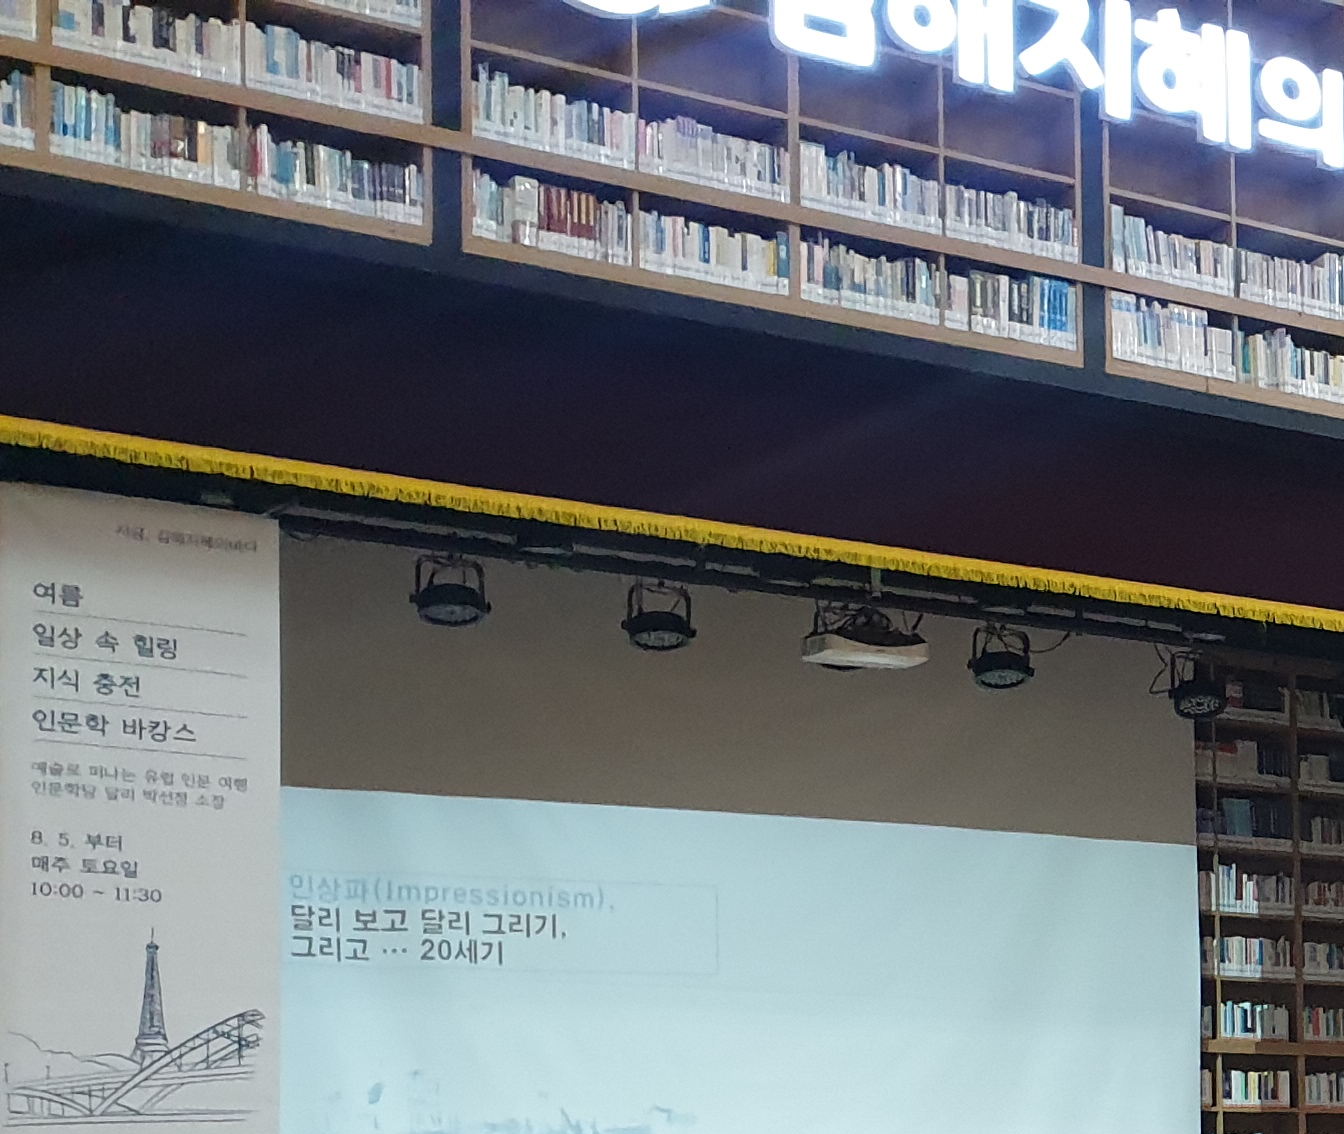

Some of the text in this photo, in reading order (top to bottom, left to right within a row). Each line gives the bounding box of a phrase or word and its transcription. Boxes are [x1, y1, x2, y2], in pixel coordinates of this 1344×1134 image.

[33, 583, 83, 607] 여름
[33, 623, 177, 660] 일상 속 힐링
[33, 667, 140, 698] 지식 충전
[33, 710, 196, 742] 인문학 바캉스
[85, 833, 122, 851] 부터
[31, 855, 138, 879] 매주 토요일
[31, 882, 83, 898] 10:00
[115, 887, 162, 903] 11:30
[290, 904, 567, 940] 달리 보고 달리 그리기,
[290, 936, 370, 963] 그리고
[420, 938, 504, 966] 20세기
